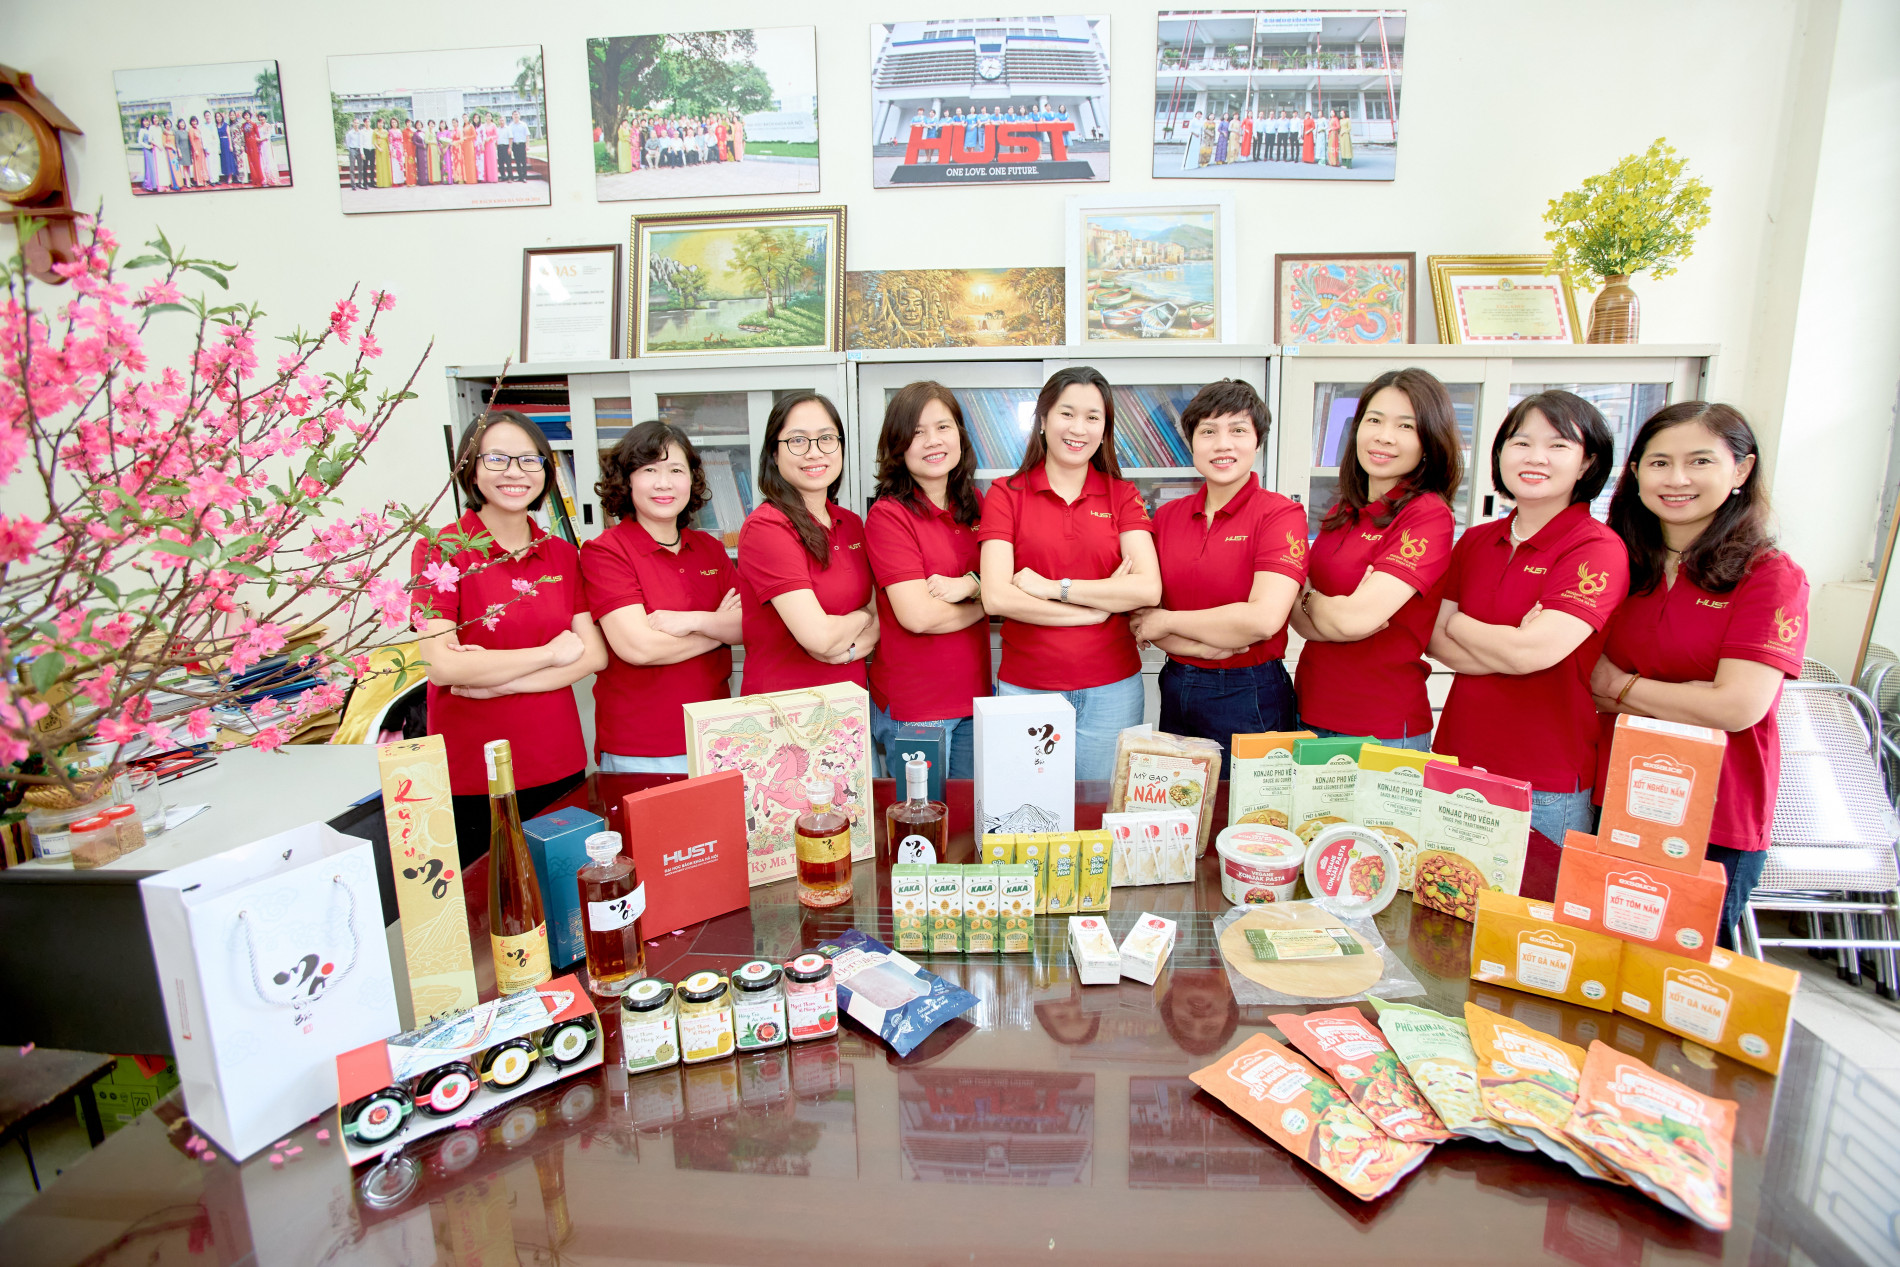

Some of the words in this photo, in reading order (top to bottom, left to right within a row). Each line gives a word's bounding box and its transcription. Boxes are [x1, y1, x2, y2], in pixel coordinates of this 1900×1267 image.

[904, 122, 1075, 165] HUST
[946, 167, 964, 176] ONE
[964, 167, 988, 176] LOVE.
[988, 166, 1006, 176] ONE
[1008, 166, 1039, 175] FUTURE.
[1091, 510, 1112, 518] HUST
[1524, 565, 1547, 574] HUST
[1696, 598, 1729, 609] HUST
[1134, 781, 1166, 804] NẤM
[1378, 783, 1400, 793] KONJAC
[1402, 787, 1413, 795] PHO
[1457, 794, 1484, 803] exnoodle
[1439, 805, 1462, 818] KONJAC
[1464, 812, 1476, 821] PHO
[1479, 815, 1499, 826] VÉGAN
[663, 840, 718, 866] HUST
[1326, 865, 1338, 891] KONJAK
[1336, 845, 1347, 864] PASTA
[898, 885, 920, 893] KAKA
[934, 884, 956, 892] KAKA
[971, 884, 993, 892] KAKA
[1006, 885, 1028, 893] KAKA
[1626, 899, 1641, 909] TÔM
[1643, 902, 1660, 915] NẤM
[1550, 958, 1566, 969] NẤM
[134, 1097, 148, 1106] 70
